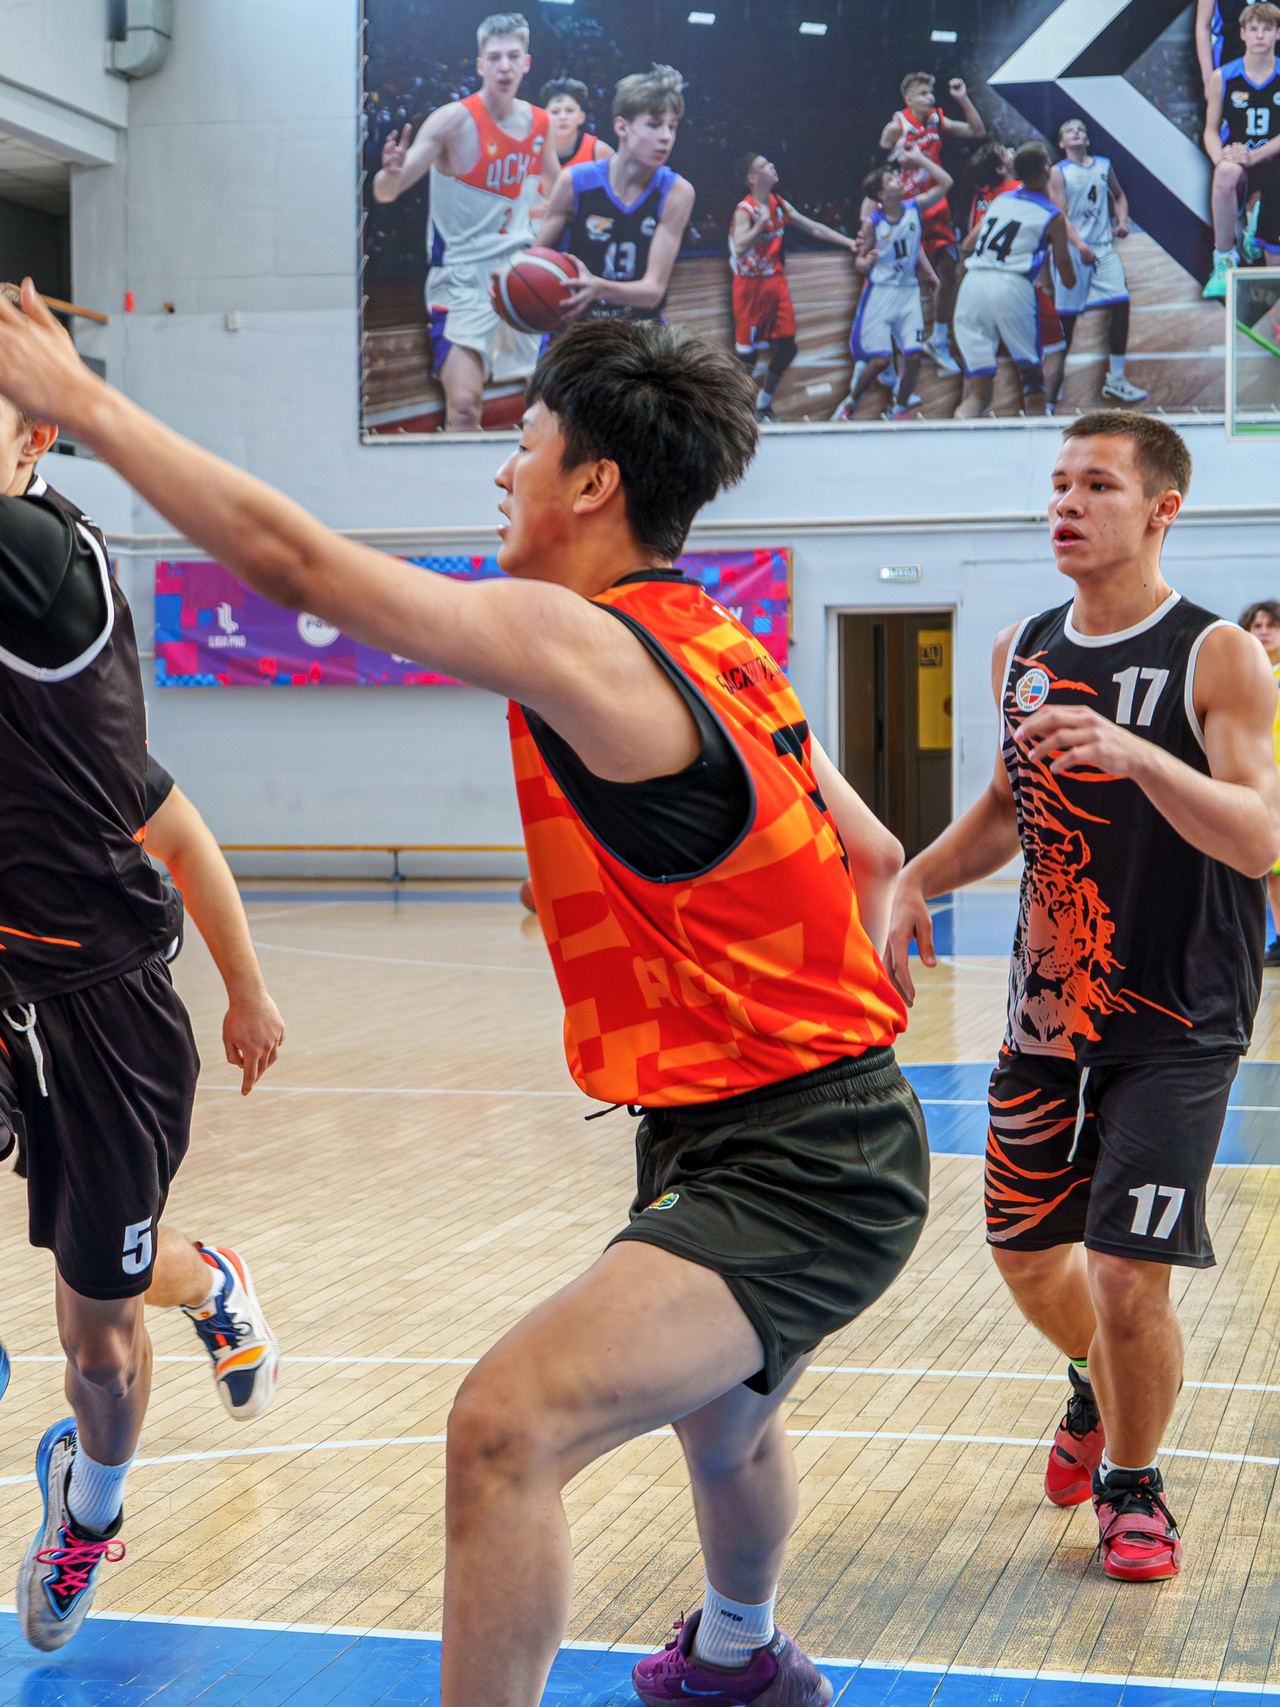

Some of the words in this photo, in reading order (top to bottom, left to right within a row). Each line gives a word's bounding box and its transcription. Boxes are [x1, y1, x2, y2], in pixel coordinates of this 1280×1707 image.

[1246, 107, 1270, 136] 13
[602, 241, 636, 280] 13
[976, 218, 1022, 261] 14
[1111, 666, 1169, 727] 17
[1128, 1183, 1186, 1240] 17
[121, 1215, 153, 1276] 5
